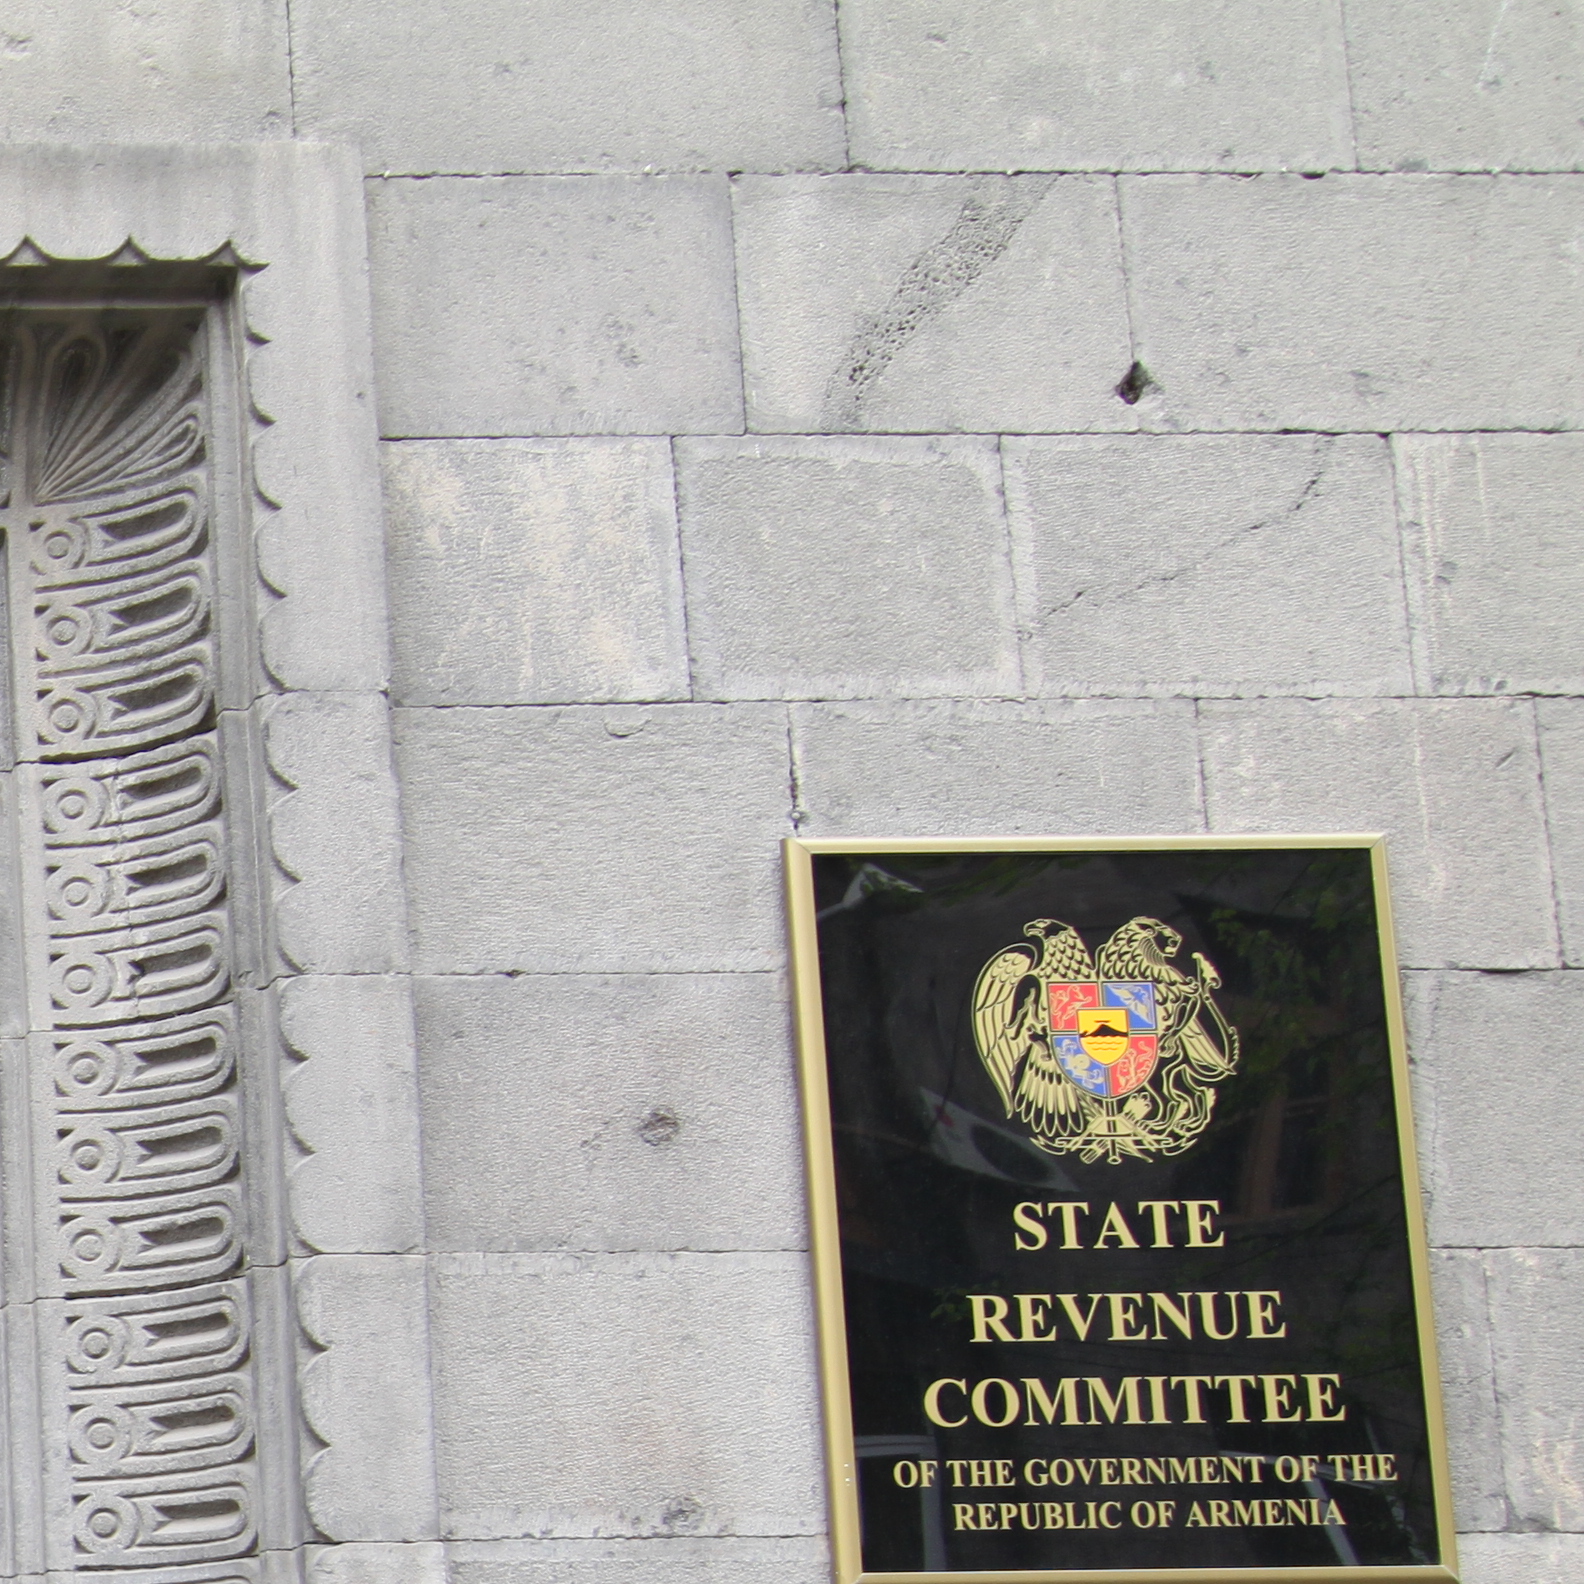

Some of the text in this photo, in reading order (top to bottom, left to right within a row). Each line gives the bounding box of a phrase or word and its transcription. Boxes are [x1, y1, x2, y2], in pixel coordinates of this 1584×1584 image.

[1013, 1199, 1224, 1251] STATE
[967, 1290, 1286, 1343] REVENUE
[924, 1373, 1345, 1428] COMMITTEE
[893, 1453, 1398, 1488] OF THE GOVERNMENT OF THE
[953, 1498, 1346, 1531] REPUBLIC OF ARMENIA
